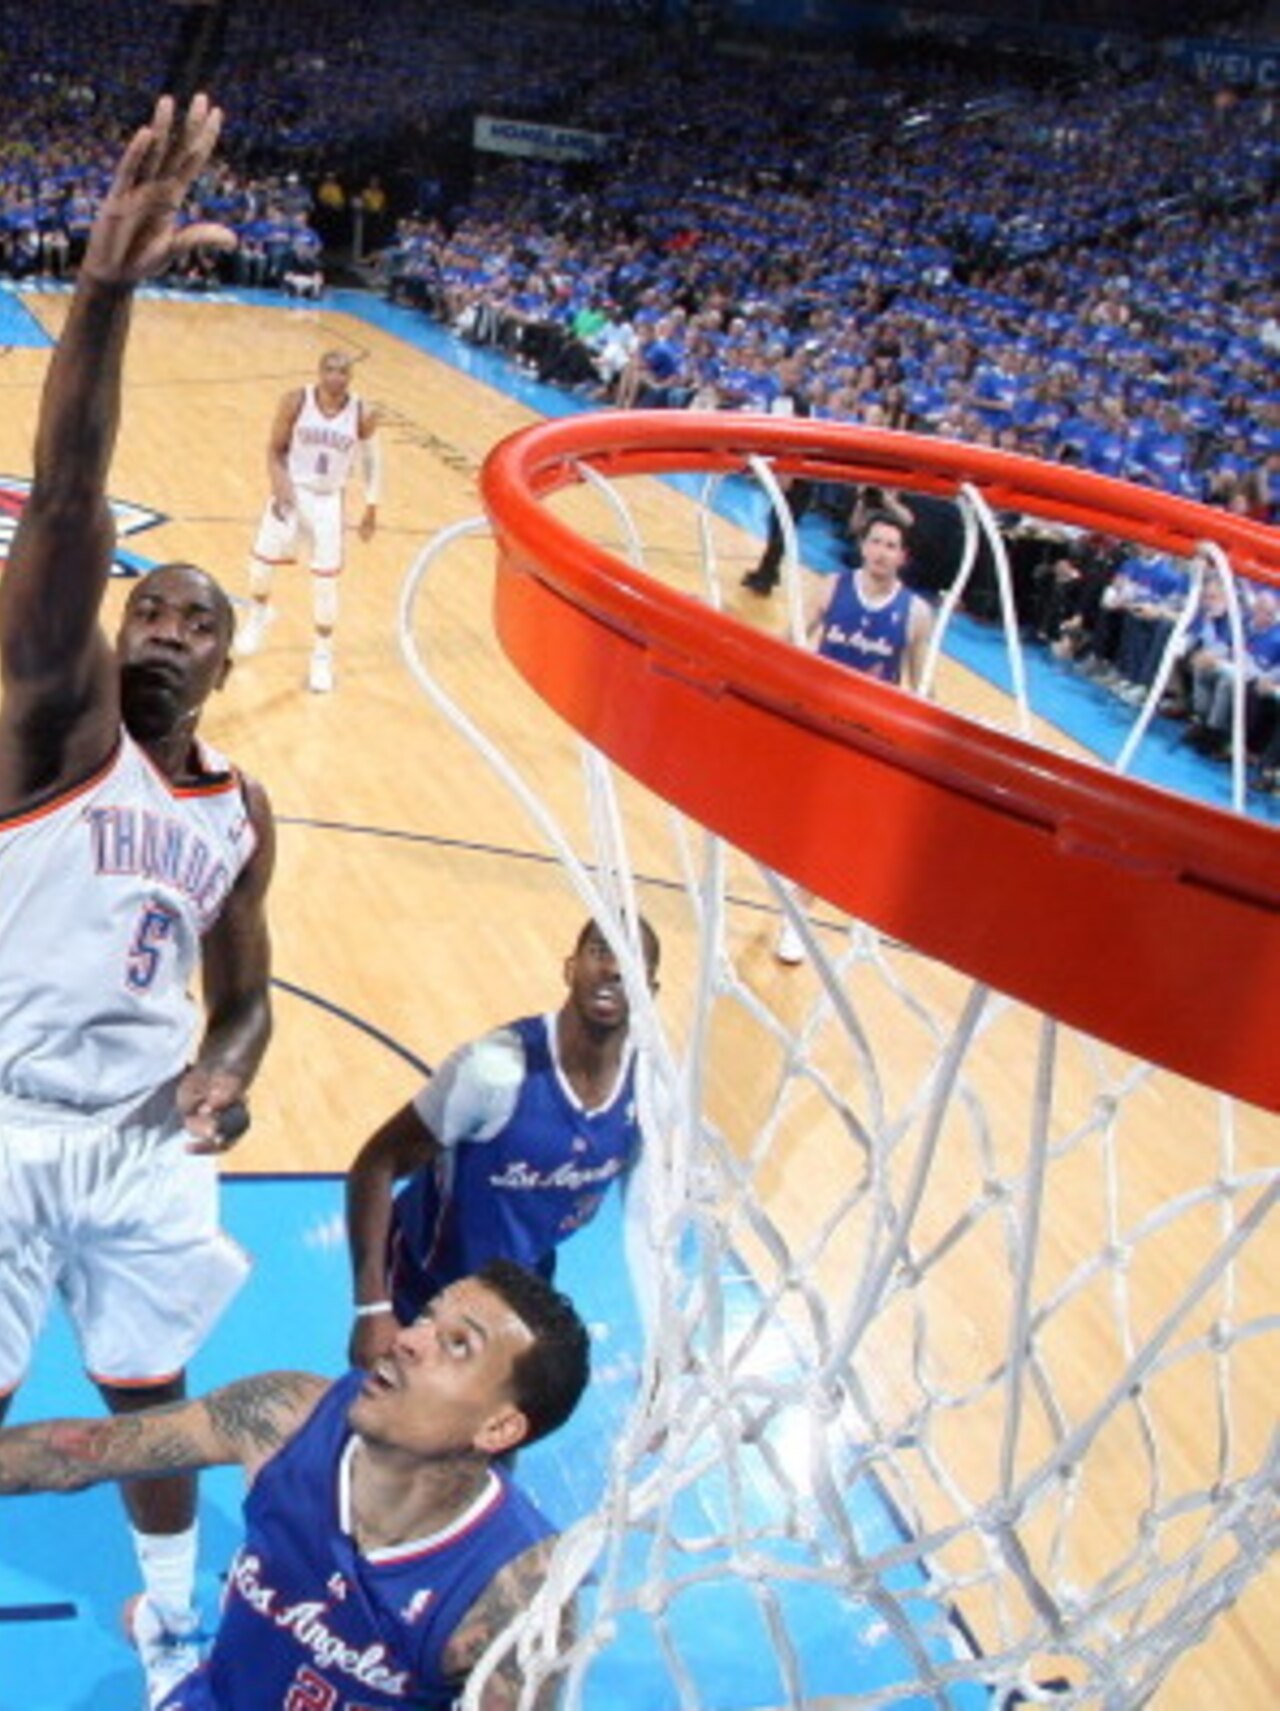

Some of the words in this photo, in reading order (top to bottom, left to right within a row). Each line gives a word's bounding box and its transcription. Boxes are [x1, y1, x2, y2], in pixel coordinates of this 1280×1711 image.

[83, 805, 230, 938] THUNDE
[125, 900, 181, 996] 5
[273, 1601, 410, 1695] Angeles
